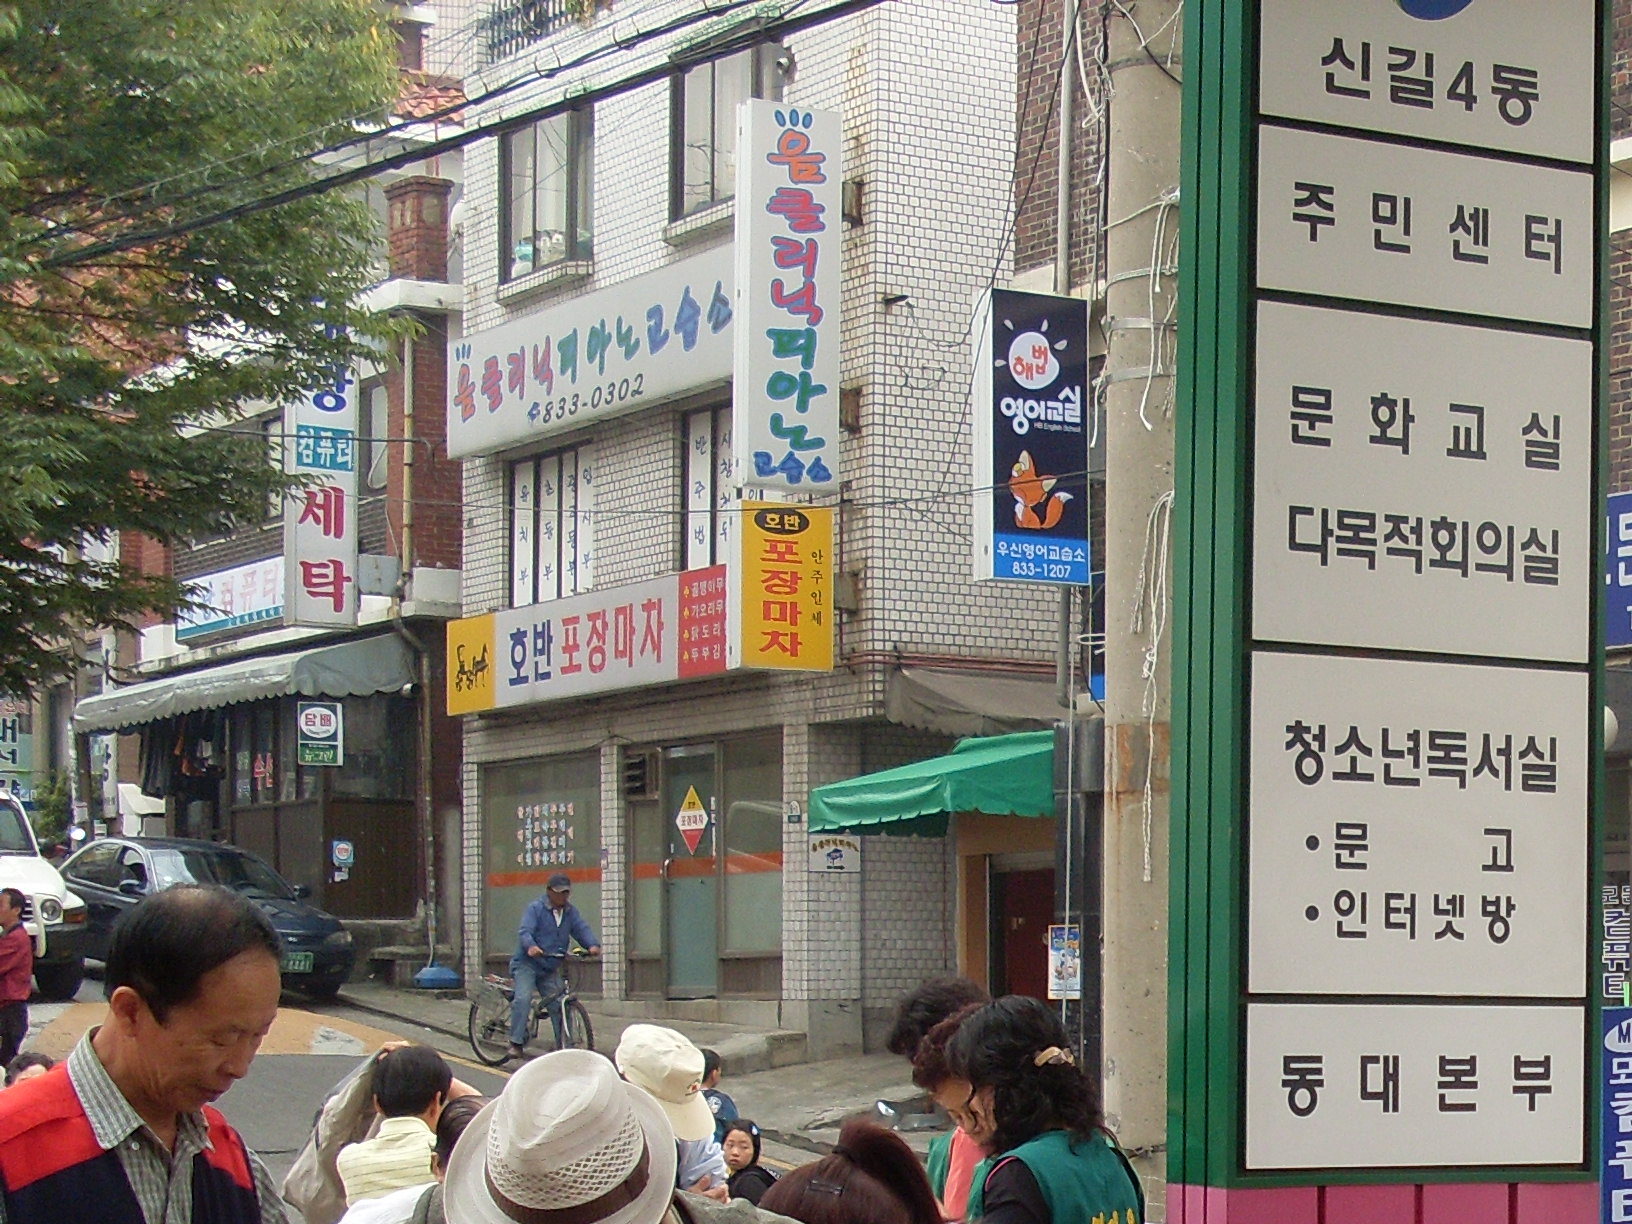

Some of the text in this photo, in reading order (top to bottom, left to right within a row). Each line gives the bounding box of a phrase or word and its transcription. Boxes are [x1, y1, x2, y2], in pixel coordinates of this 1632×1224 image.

[1320, 37, 1540, 126] 신길4동
[1013, 344, 1049, 381] 해법
[542, 373, 644, 424] 833-0302
[1000, 385, 1081, 435] 영어교실
[298, 429, 353, 470] 컴퓨터
[765, 513, 800, 530] 호반
[1288, 505, 1559, 587] 다목적회의실
[299, 486, 351, 613] 세탁
[997, 541, 1086, 562] 우신영어교습소
[1012, 562, 1071, 578] 833-1207
[692, 577, 727, 597] 골뱅이무
[692, 600, 727, 619] 가오리무
[759, 538, 802, 658] 포장마차
[508, 597, 665, 687] 호반 포장마차
[1284, 720, 1557, 793] 청소년독서실
[1333, 888, 1516, 944] 인터넷방
